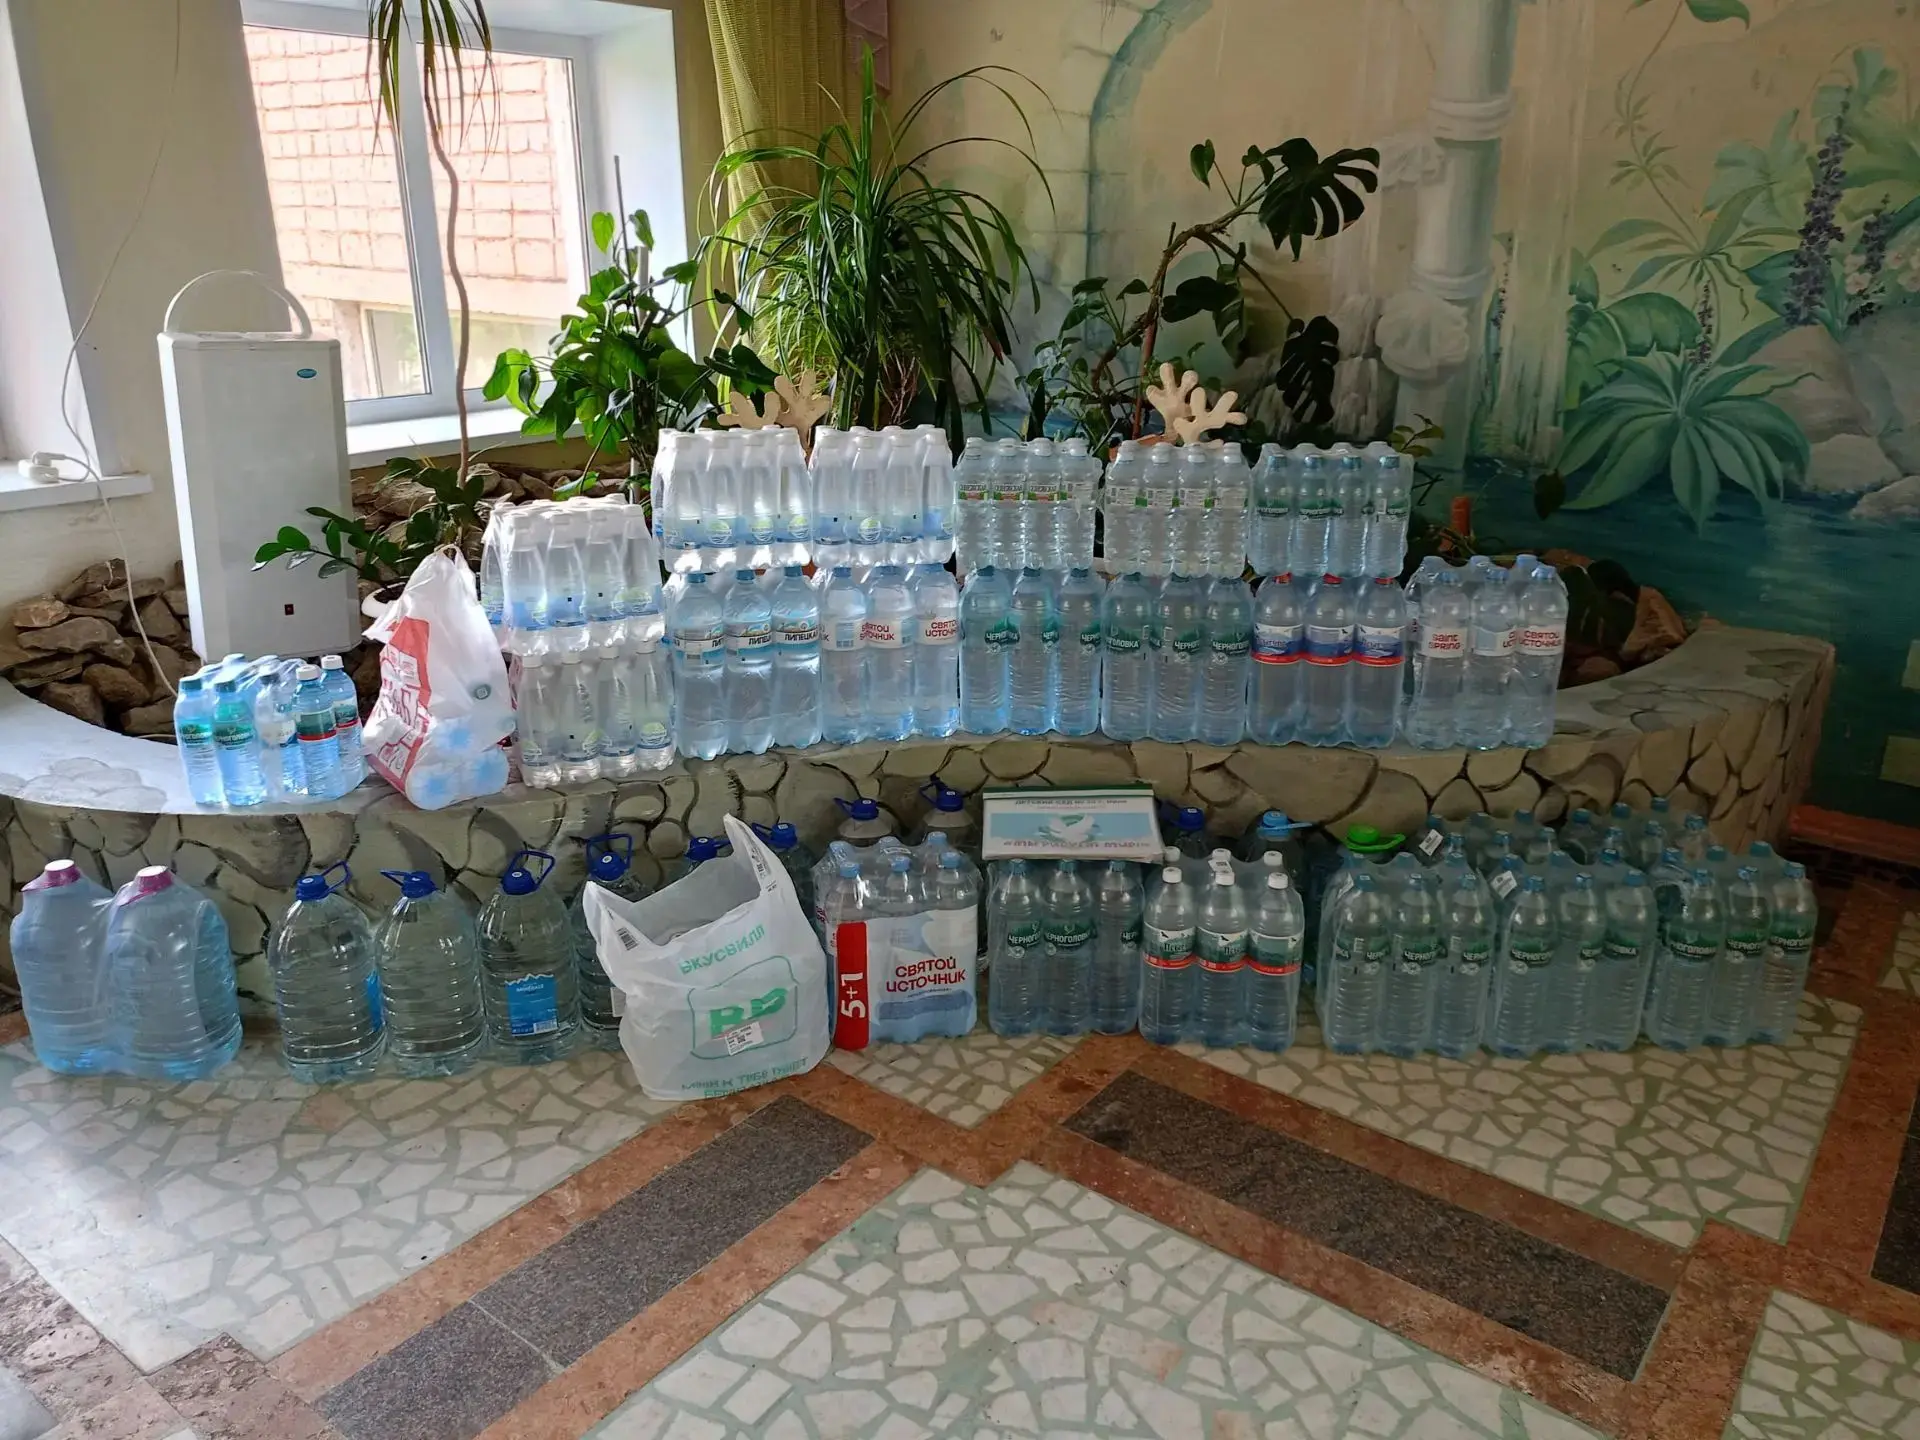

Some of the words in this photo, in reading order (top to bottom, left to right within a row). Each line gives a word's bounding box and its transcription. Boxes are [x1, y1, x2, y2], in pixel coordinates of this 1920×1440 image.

[895, 956, 957, 978] СВЯТОЙ
[886, 969, 966, 993] ИСТОЧНИК
[840, 972, 866, 1018] 5+1
